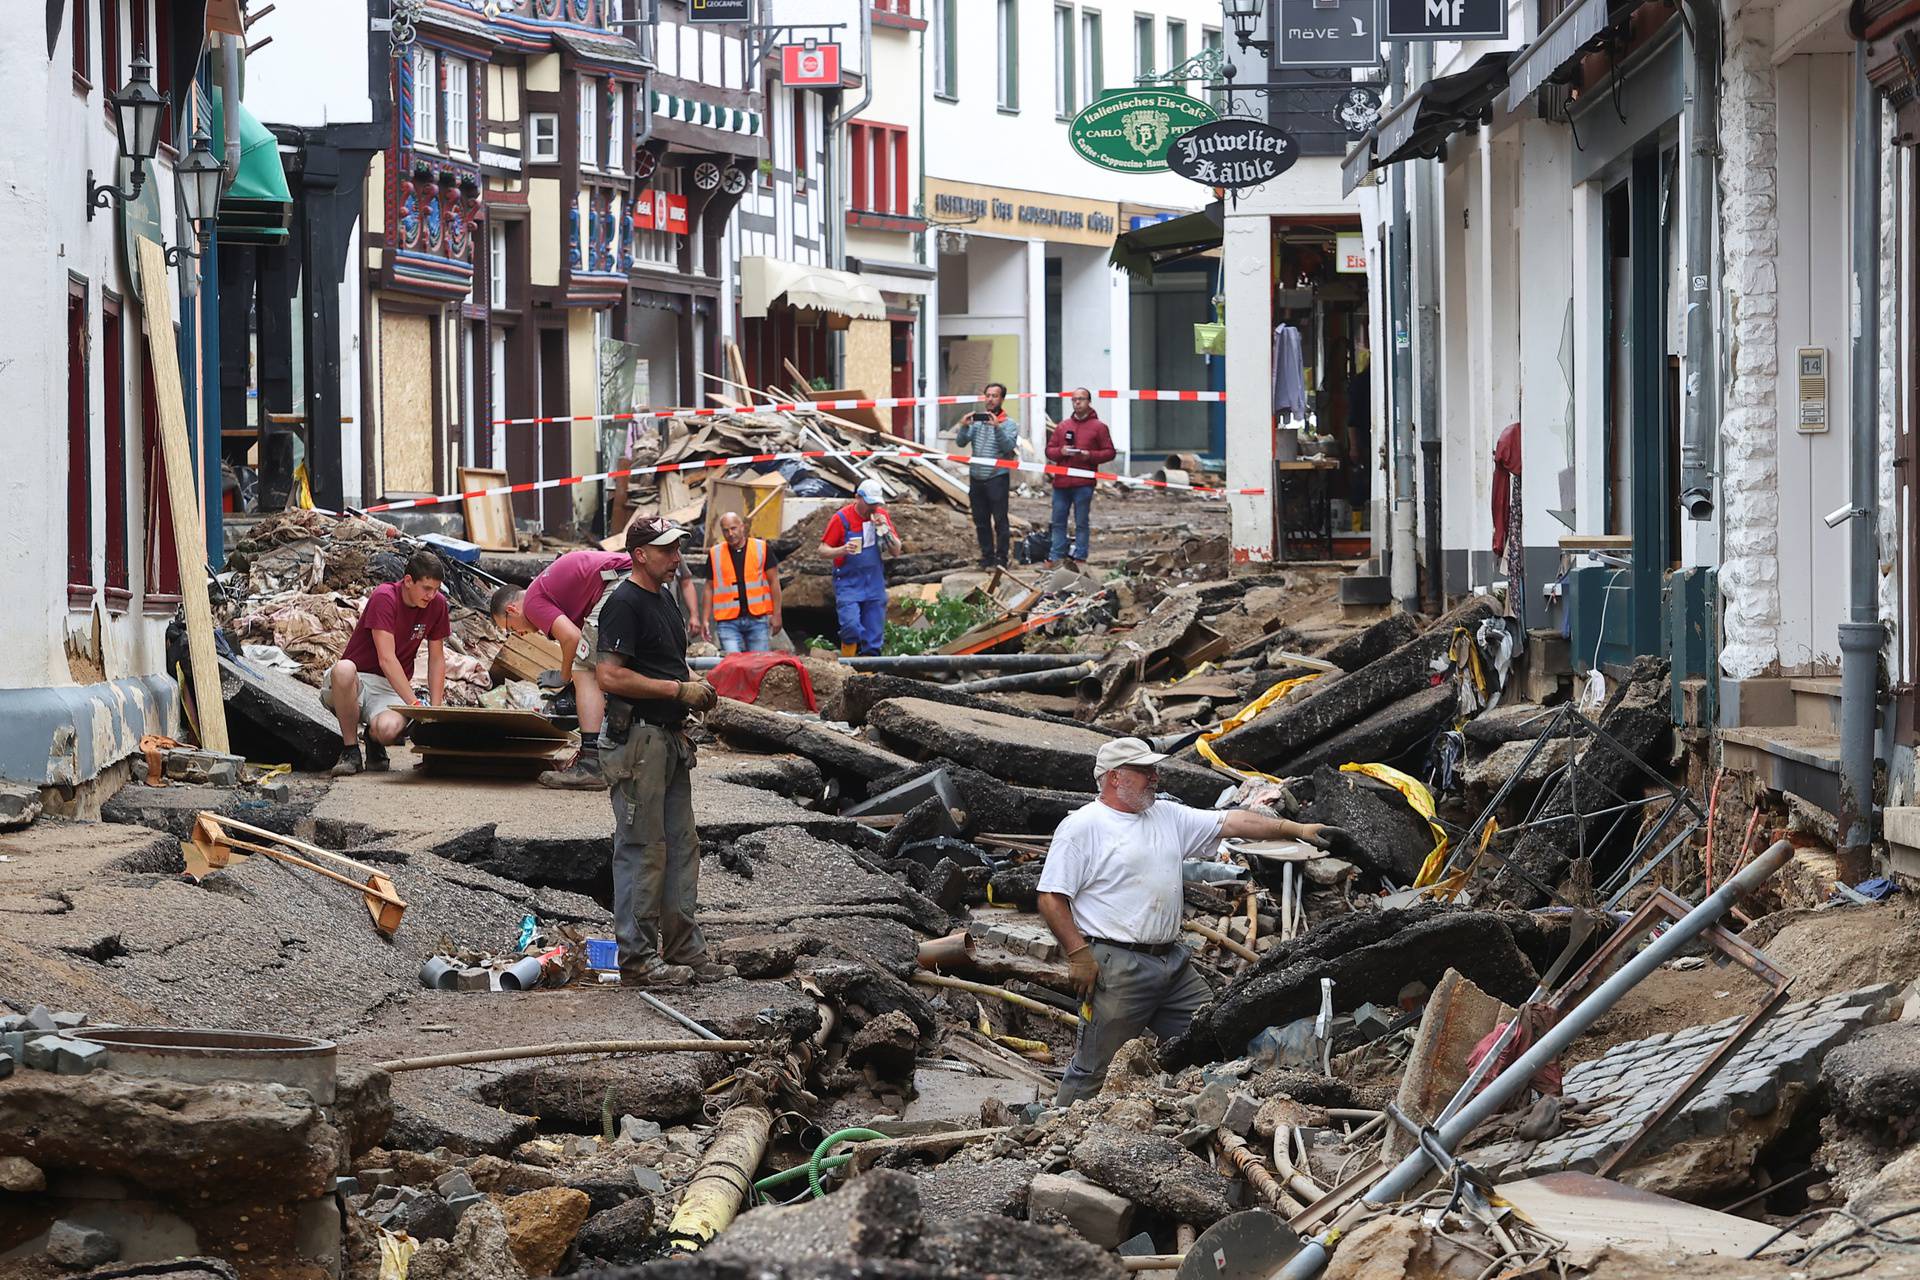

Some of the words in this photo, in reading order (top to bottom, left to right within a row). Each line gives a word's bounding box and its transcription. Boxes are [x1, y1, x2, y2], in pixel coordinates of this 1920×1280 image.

[1083, 96, 1155, 125] Italienisches
[1157, 96, 1207, 120] Eis-Café
[1086, 129, 1122, 138] CARLO
[1176, 129, 1288, 165] Juwelier
[1100, 153, 1143, 169] Cappuccino
[1190, 158, 1276, 183] Kälble
[1346, 255, 1366, 268] Eis
[1804, 361, 1820, 372] 14
